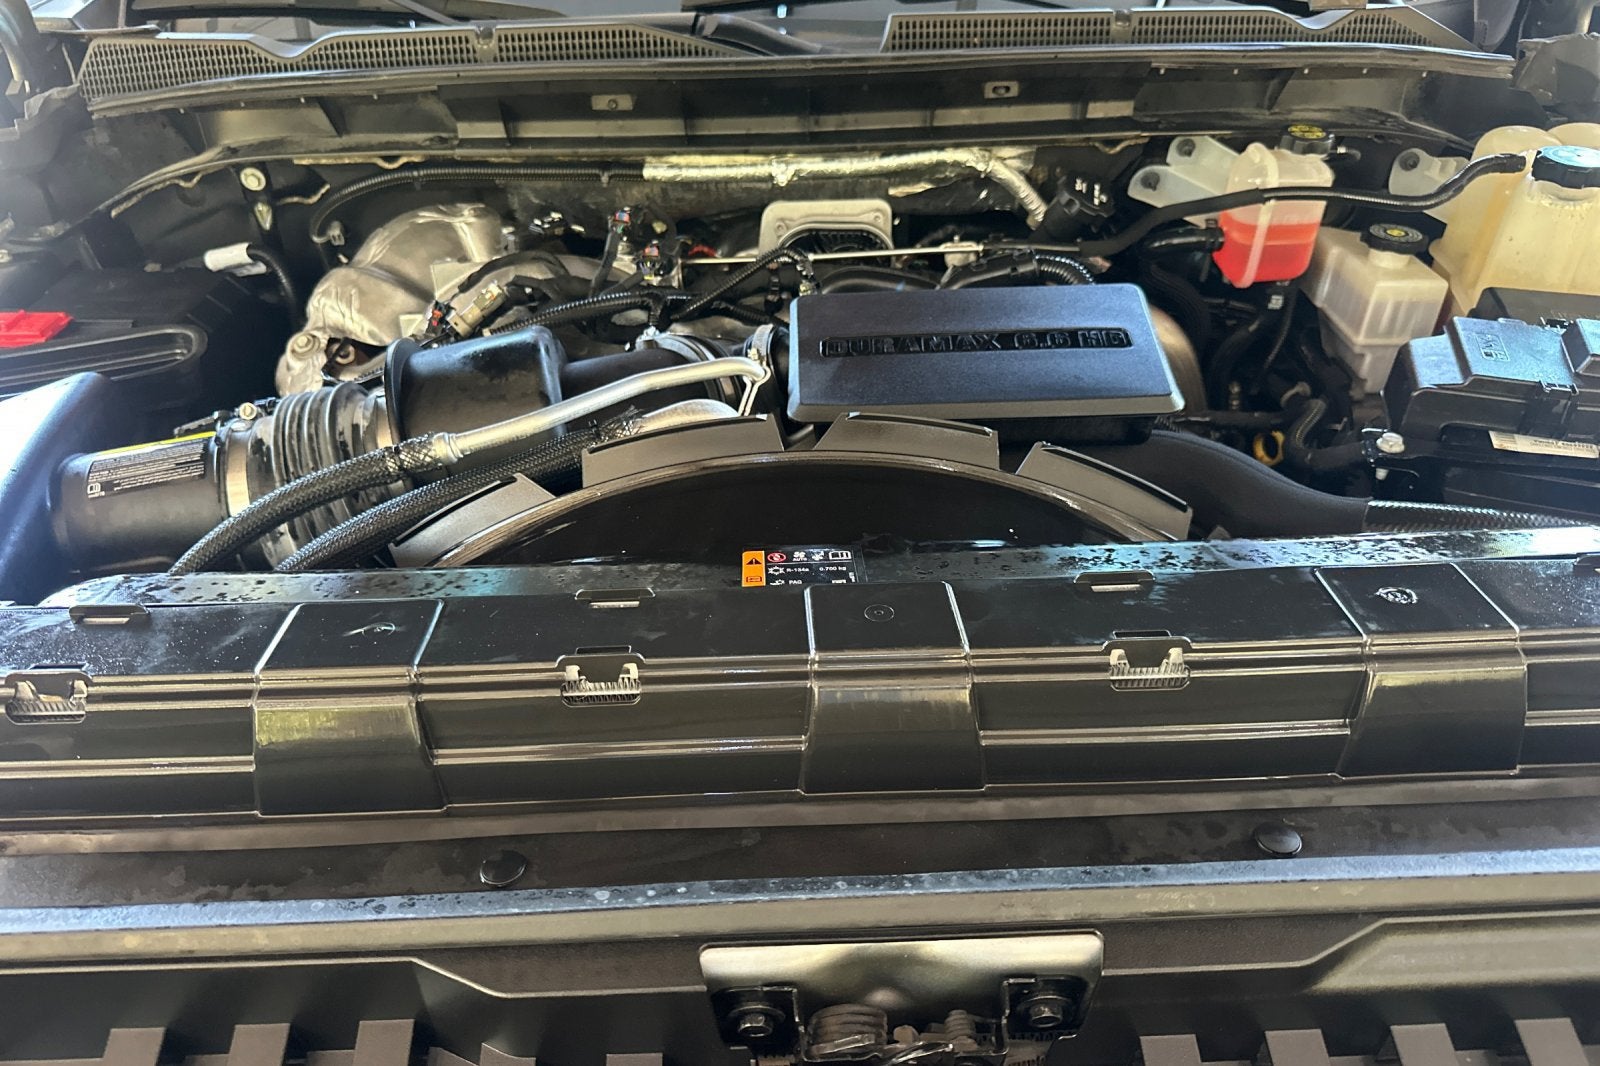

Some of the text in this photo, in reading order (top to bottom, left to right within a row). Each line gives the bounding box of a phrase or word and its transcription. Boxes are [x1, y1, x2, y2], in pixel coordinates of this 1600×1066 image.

[825, 329, 1129, 355] DURAMAX 6.6 HD
